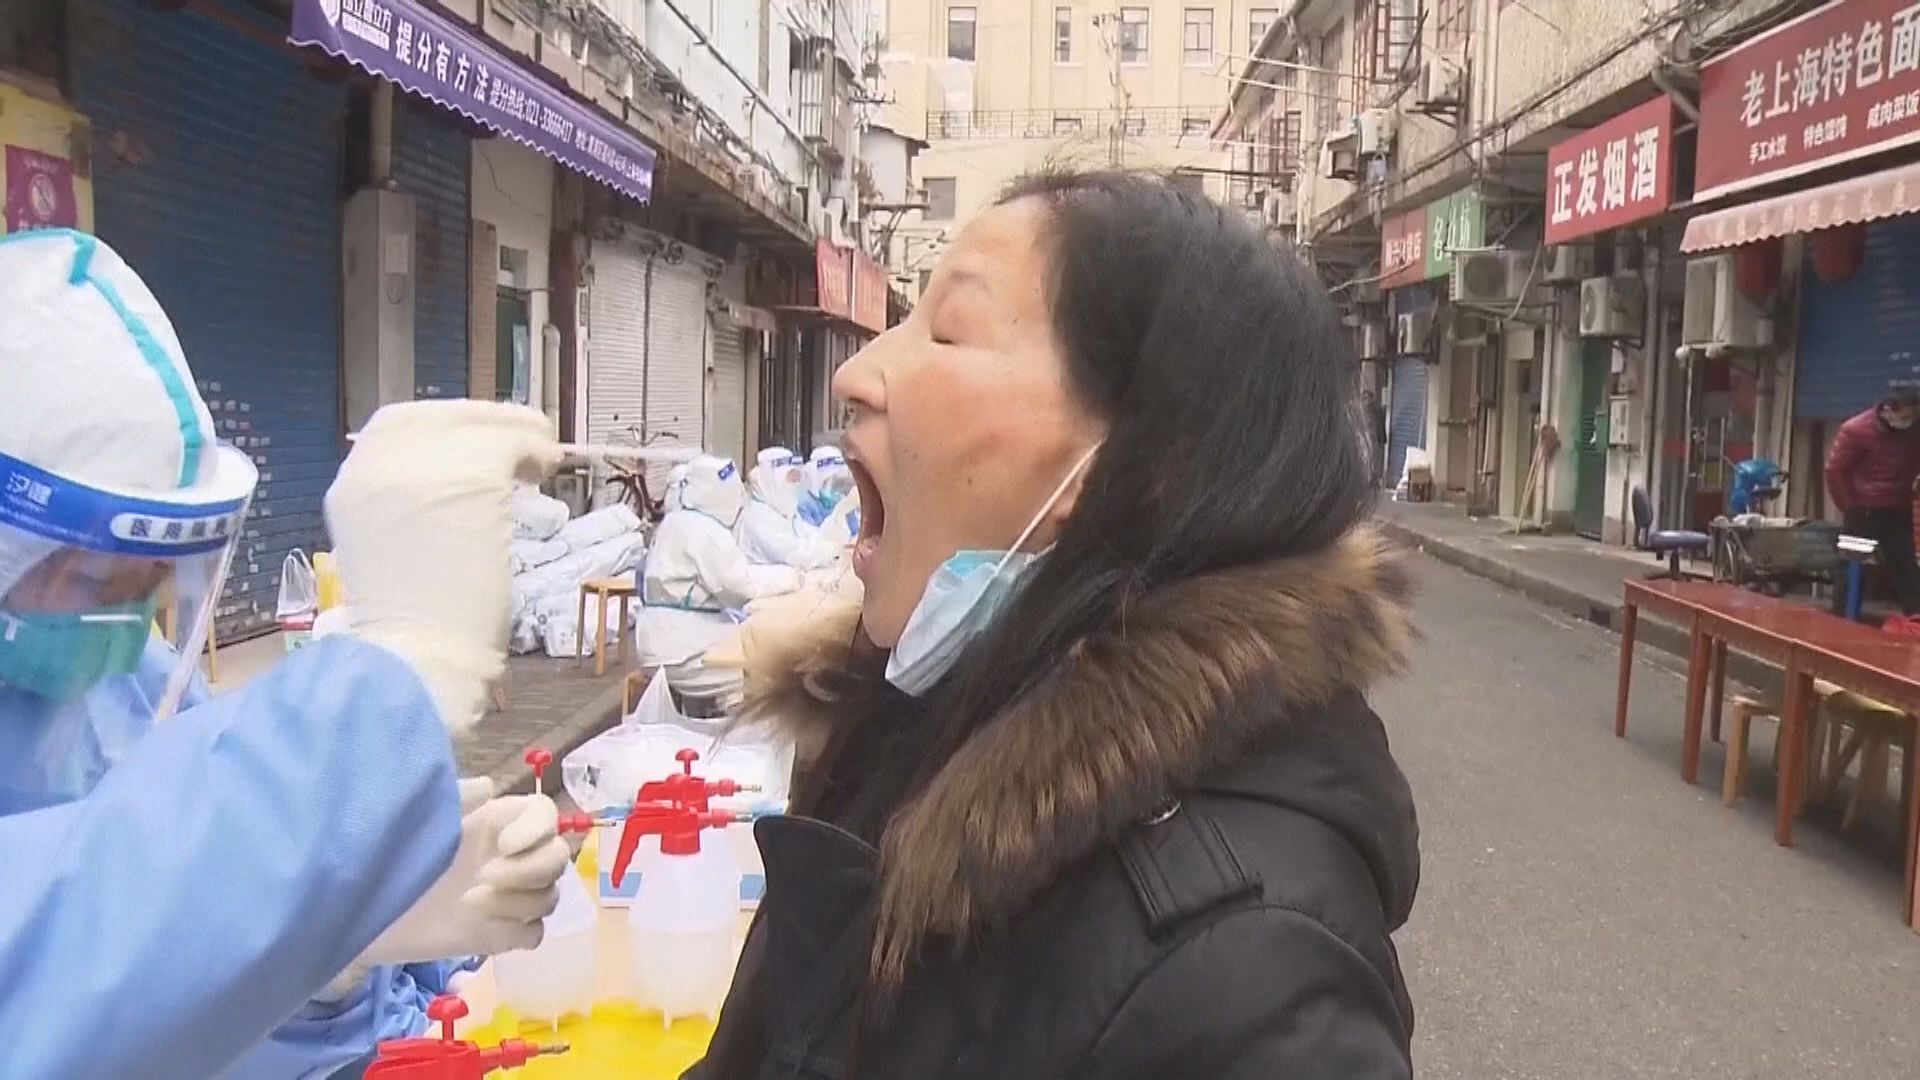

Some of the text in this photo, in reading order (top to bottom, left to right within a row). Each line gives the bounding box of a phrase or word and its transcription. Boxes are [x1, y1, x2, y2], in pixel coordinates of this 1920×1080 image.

[395, 18, 489, 105] 提分有方法
[1740, 9, 1920, 128] 老上海特色面
[1551, 126, 1659, 225] 正发烟酒
